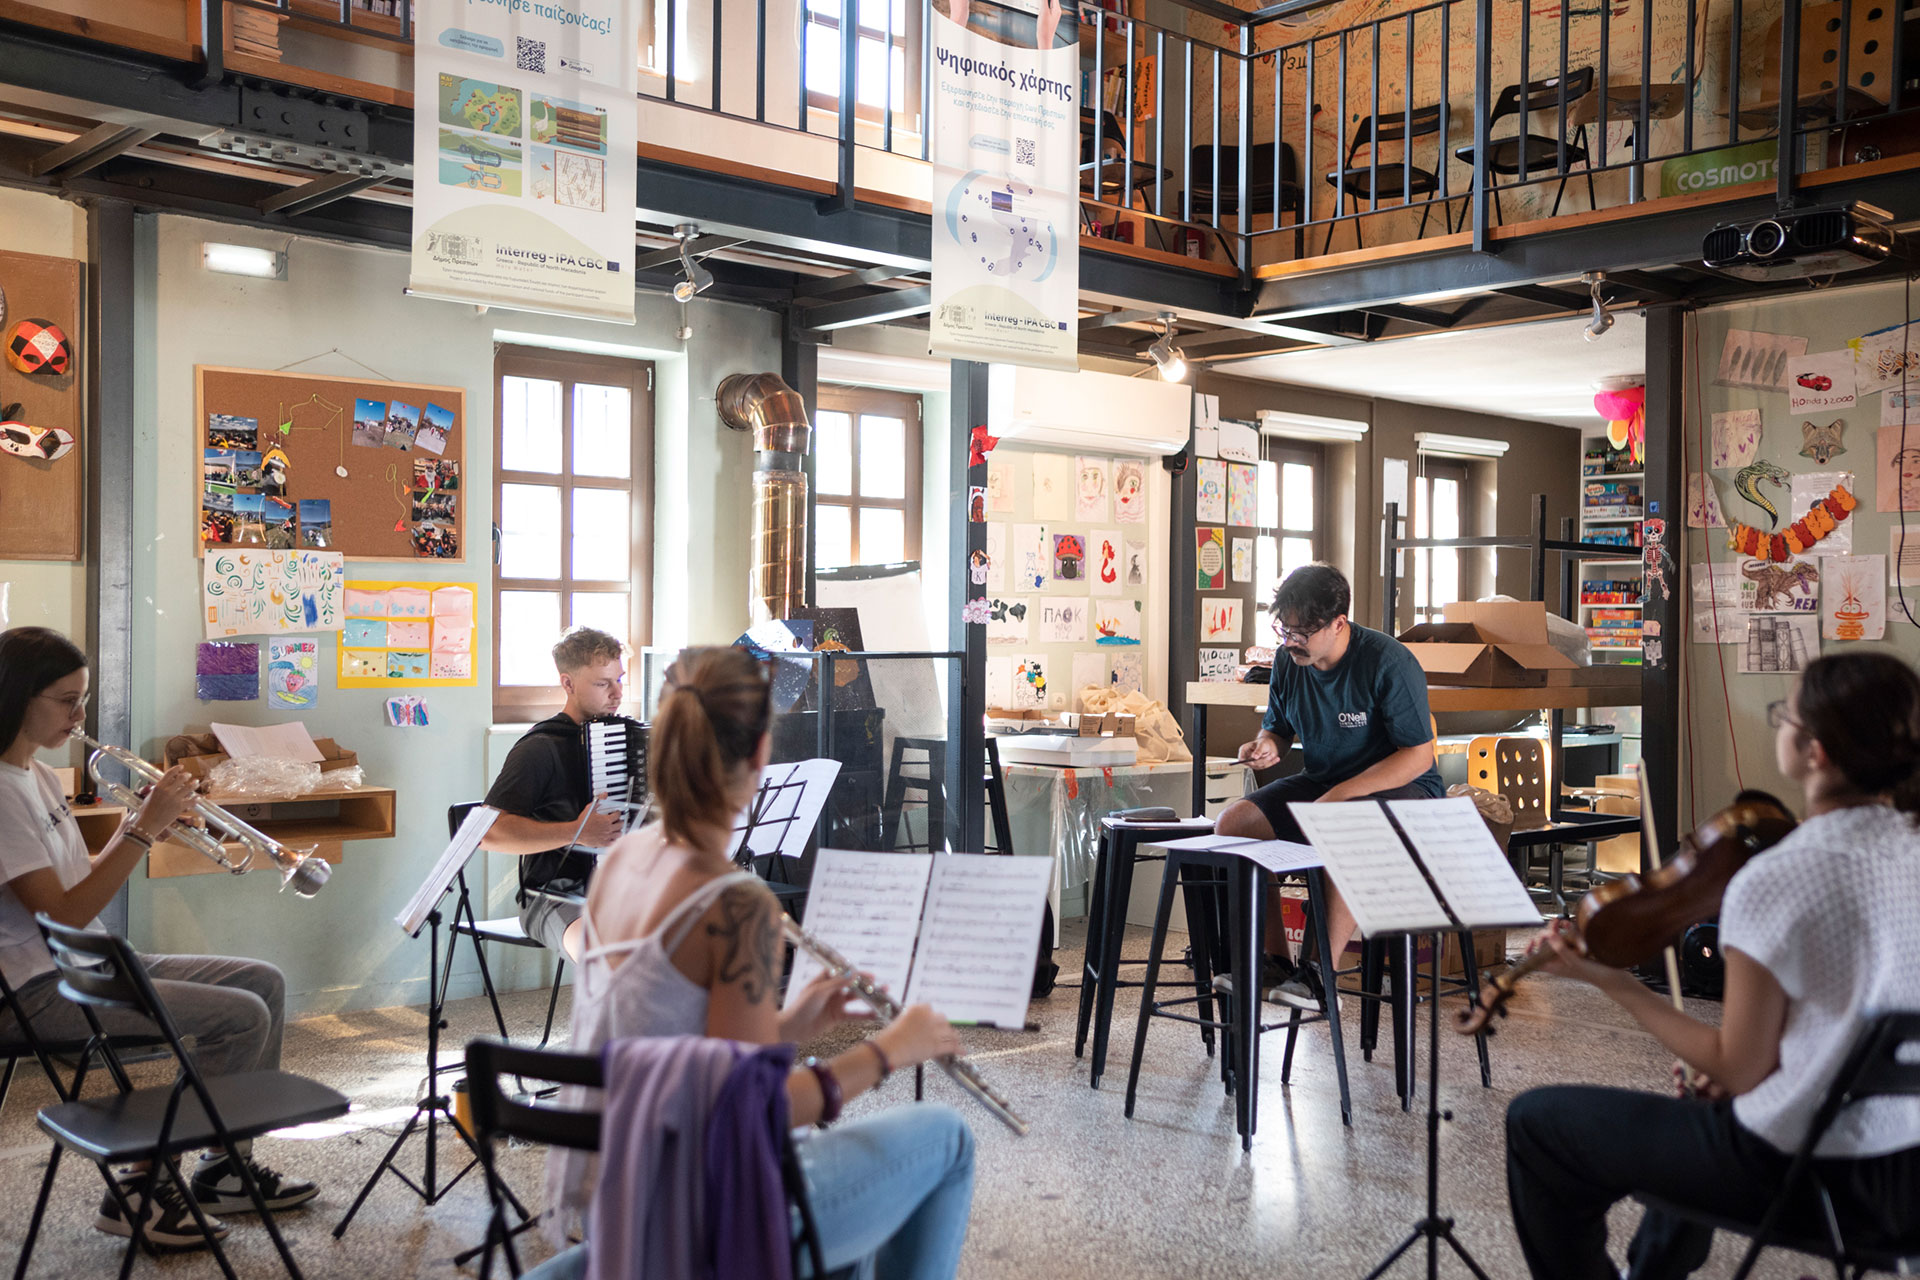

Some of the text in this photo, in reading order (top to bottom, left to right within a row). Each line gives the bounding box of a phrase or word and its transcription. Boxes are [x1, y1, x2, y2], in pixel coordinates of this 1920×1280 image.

[936, 46, 1072, 102] Ψηφιακός χάρτης
[496, 243, 547, 263] Interreg
[577, 256, 603, 270] CBC
[1793, 598, 1817, 610] REX
[1044, 606, 1082, 624] ΠΑΟΚ
[271, 642, 315, 660] SUMMER
[1338, 711, 1367, 722] O'Neill
